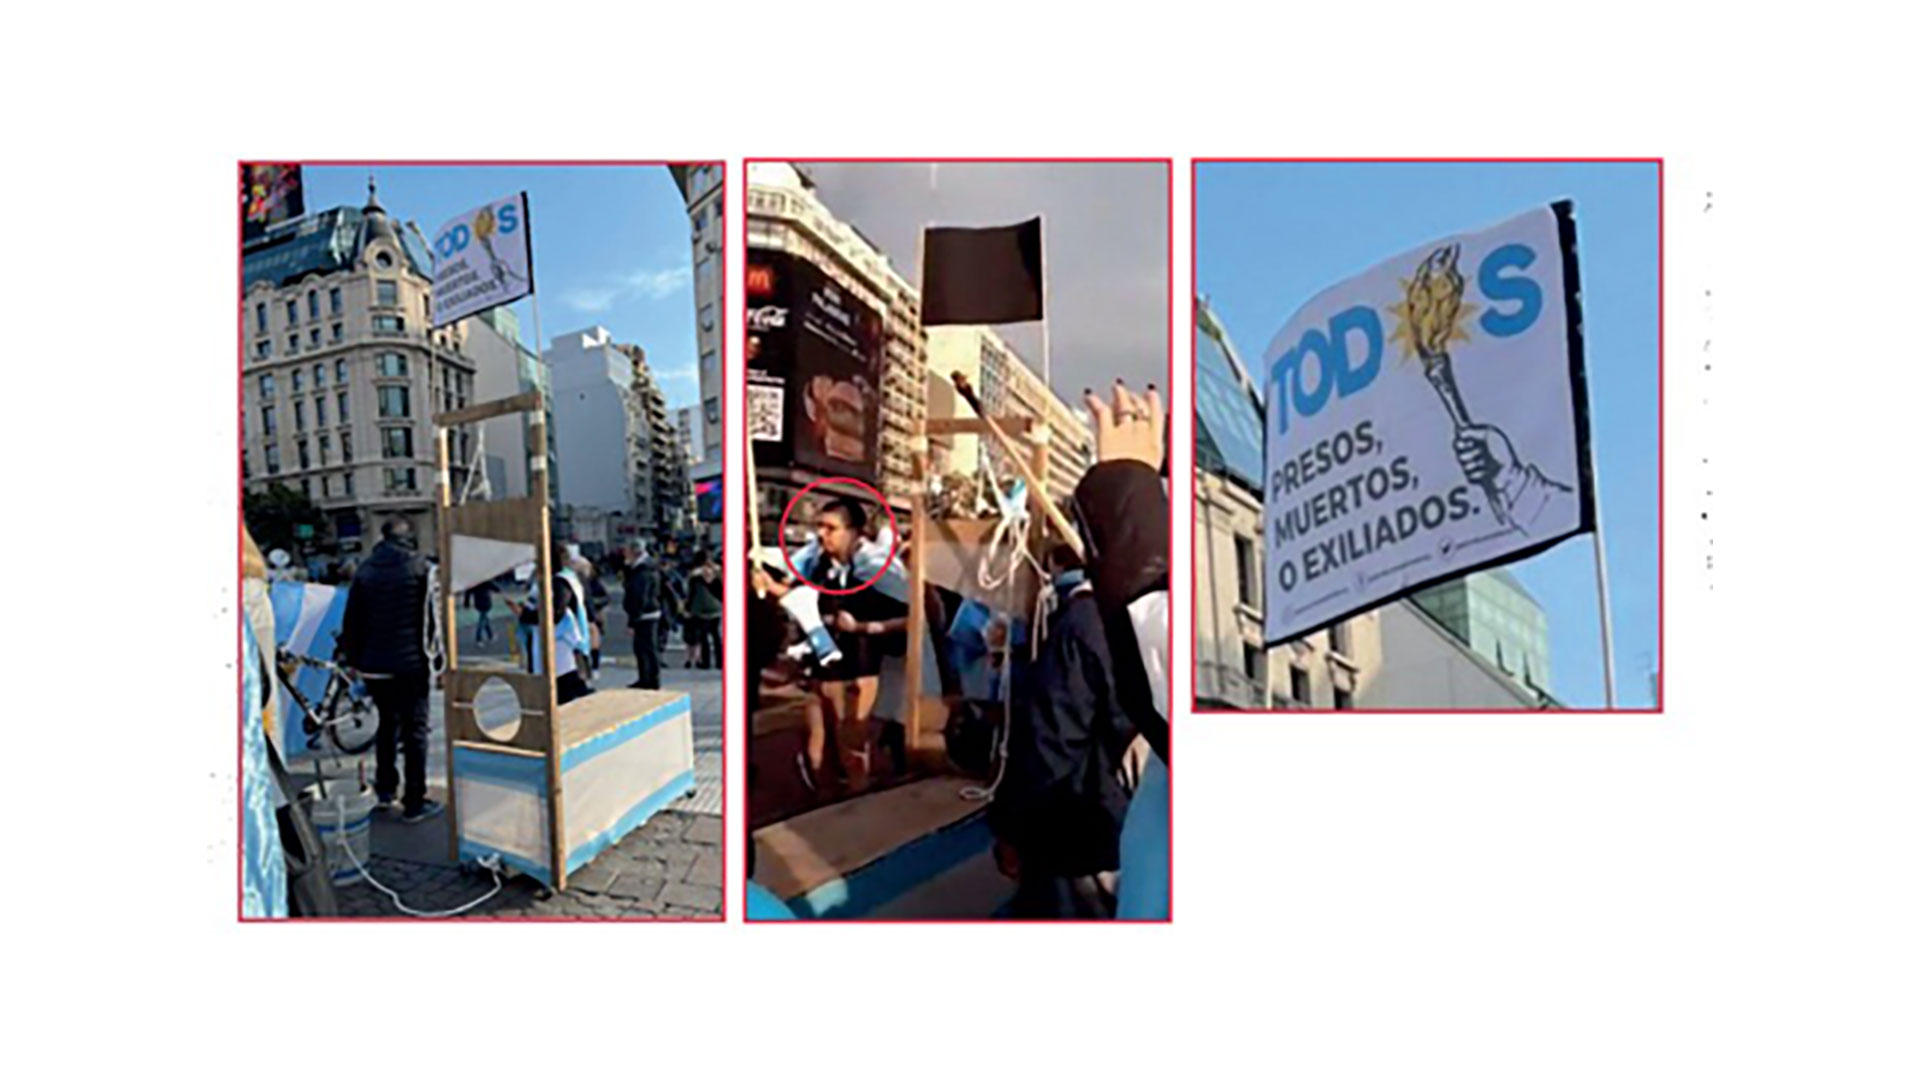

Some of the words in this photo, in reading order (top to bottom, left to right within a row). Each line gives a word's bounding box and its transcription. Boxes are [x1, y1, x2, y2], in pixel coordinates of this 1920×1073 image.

[1271, 420, 1384, 499] PRESOS,
[1274, 456, 1420, 549] MUERTOS,
[1278, 560, 1298, 592] O
[1304, 486, 1481, 581] EXILIADOS.
